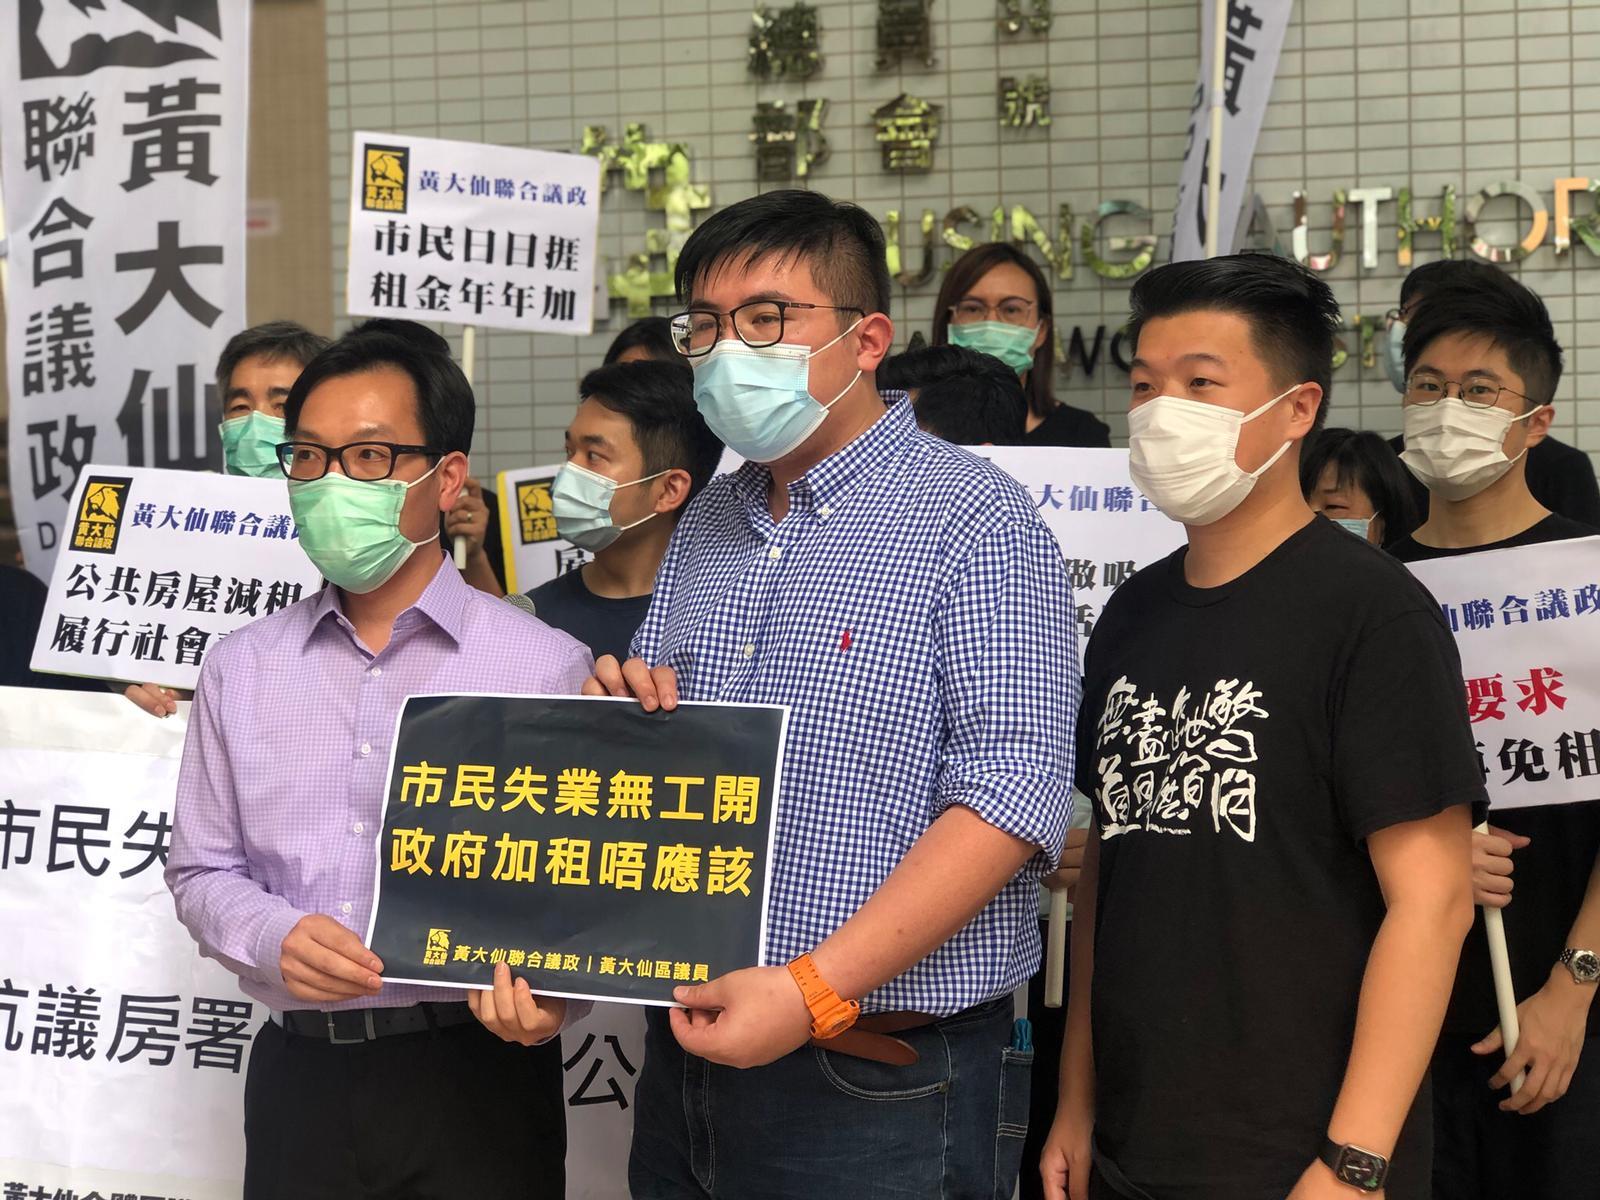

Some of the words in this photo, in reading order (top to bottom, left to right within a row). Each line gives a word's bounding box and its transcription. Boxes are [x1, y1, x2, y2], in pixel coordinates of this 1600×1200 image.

[418, 170, 587, 206] 黃大仙聯合議政
[374, 220, 580, 272] 市民日日捱
[22, 91, 98, 503] 聯合議政
[115, 77, 224, 475] 黃大仙
[370, 271, 577, 322] 租金年年加
[50, 613, 236, 667] 履行社會
[1464, 667, 1568, 724] 要求
[400, 761, 760, 825] 市民失業無工開
[391, 827, 754, 897] 政府加租唔應該
[454, 944, 580, 972] 黃大仙聯合議政
[599, 957, 709, 983] 黃大仙區議員
[563, 1032, 637, 1111] 公
